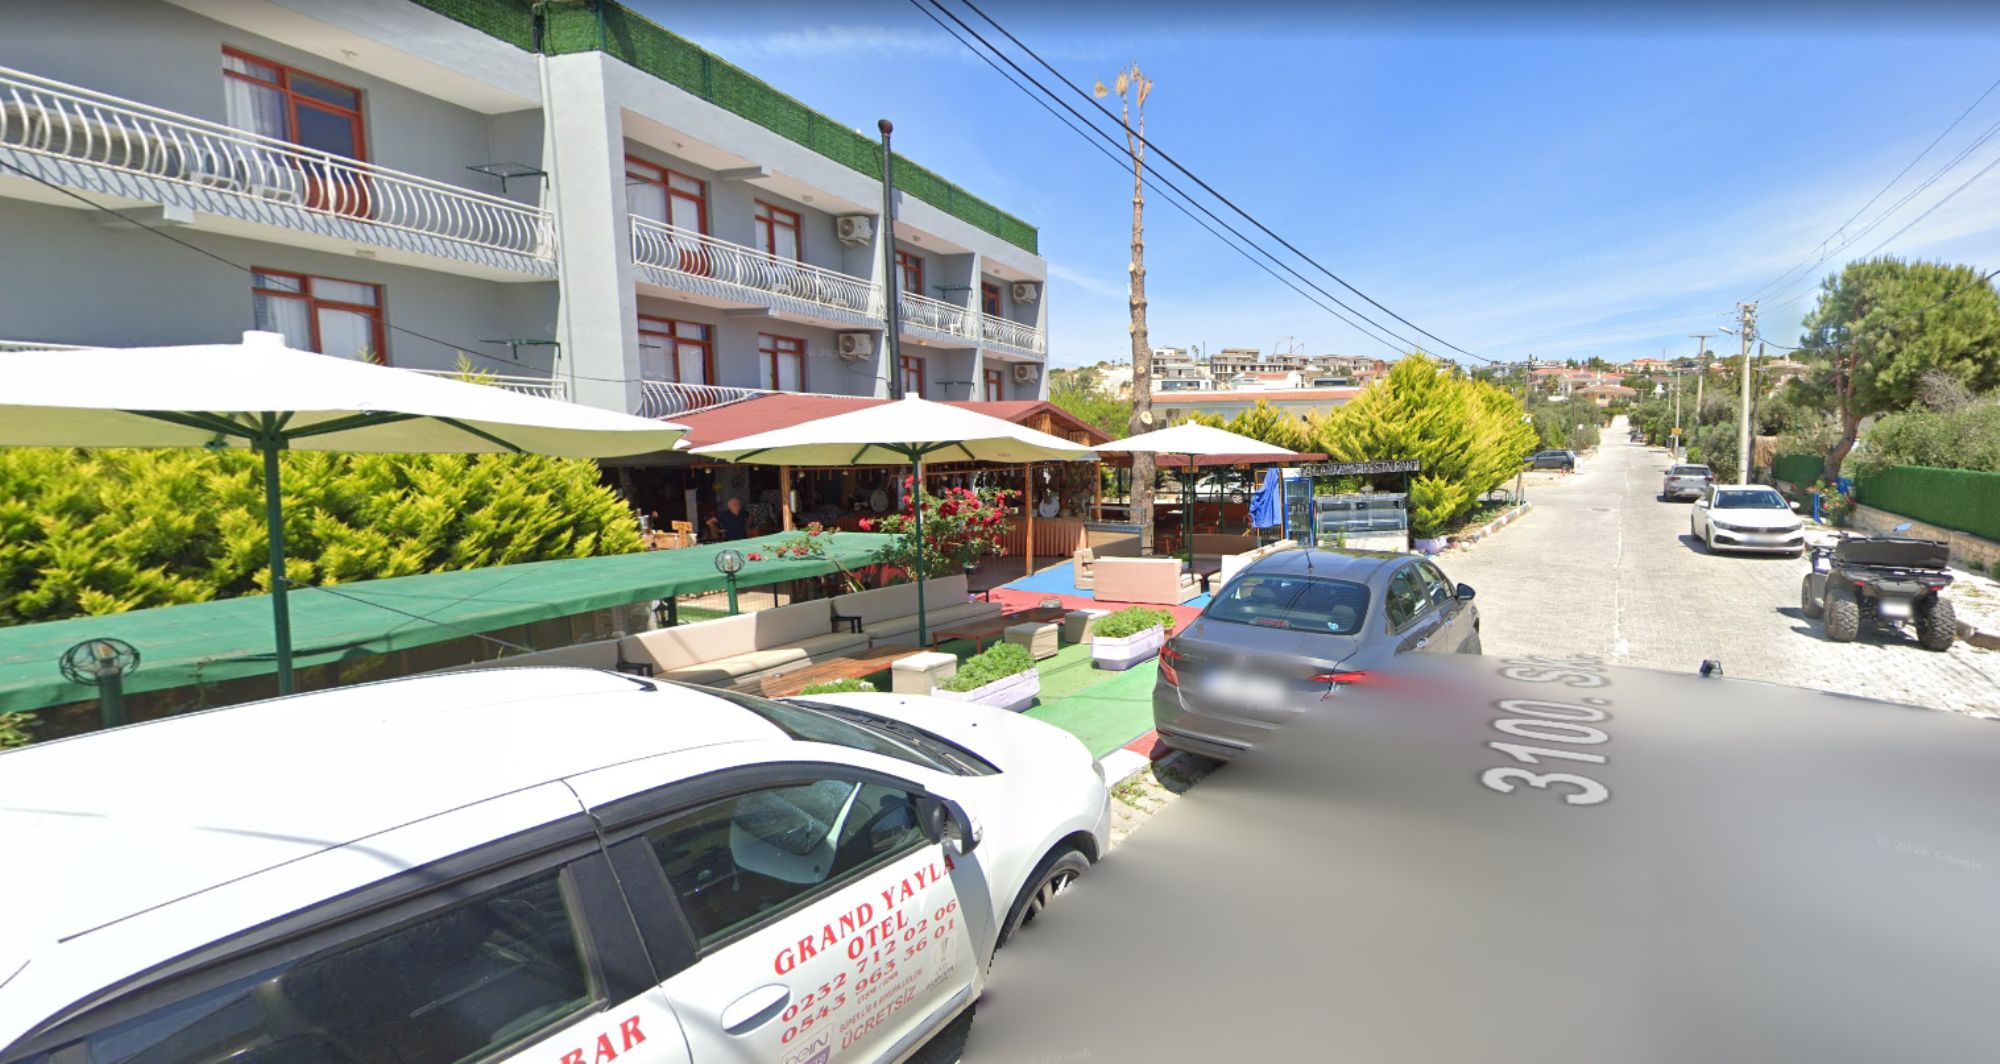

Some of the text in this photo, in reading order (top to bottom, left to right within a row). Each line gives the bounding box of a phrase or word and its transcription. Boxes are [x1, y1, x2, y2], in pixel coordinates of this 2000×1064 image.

[775, 854, 955, 975] GRAND YAYLA
[782, 899, 957, 1022] 0232 712 02 06
[847, 909, 908, 960] OTEL
[781, 992, 846, 1044] 0543
[855, 959, 896, 996] 963
[903, 937, 928, 962] 36
[934, 918, 955, 939] 01
[842, 984, 917, 1050] ÜCRETSİZ
